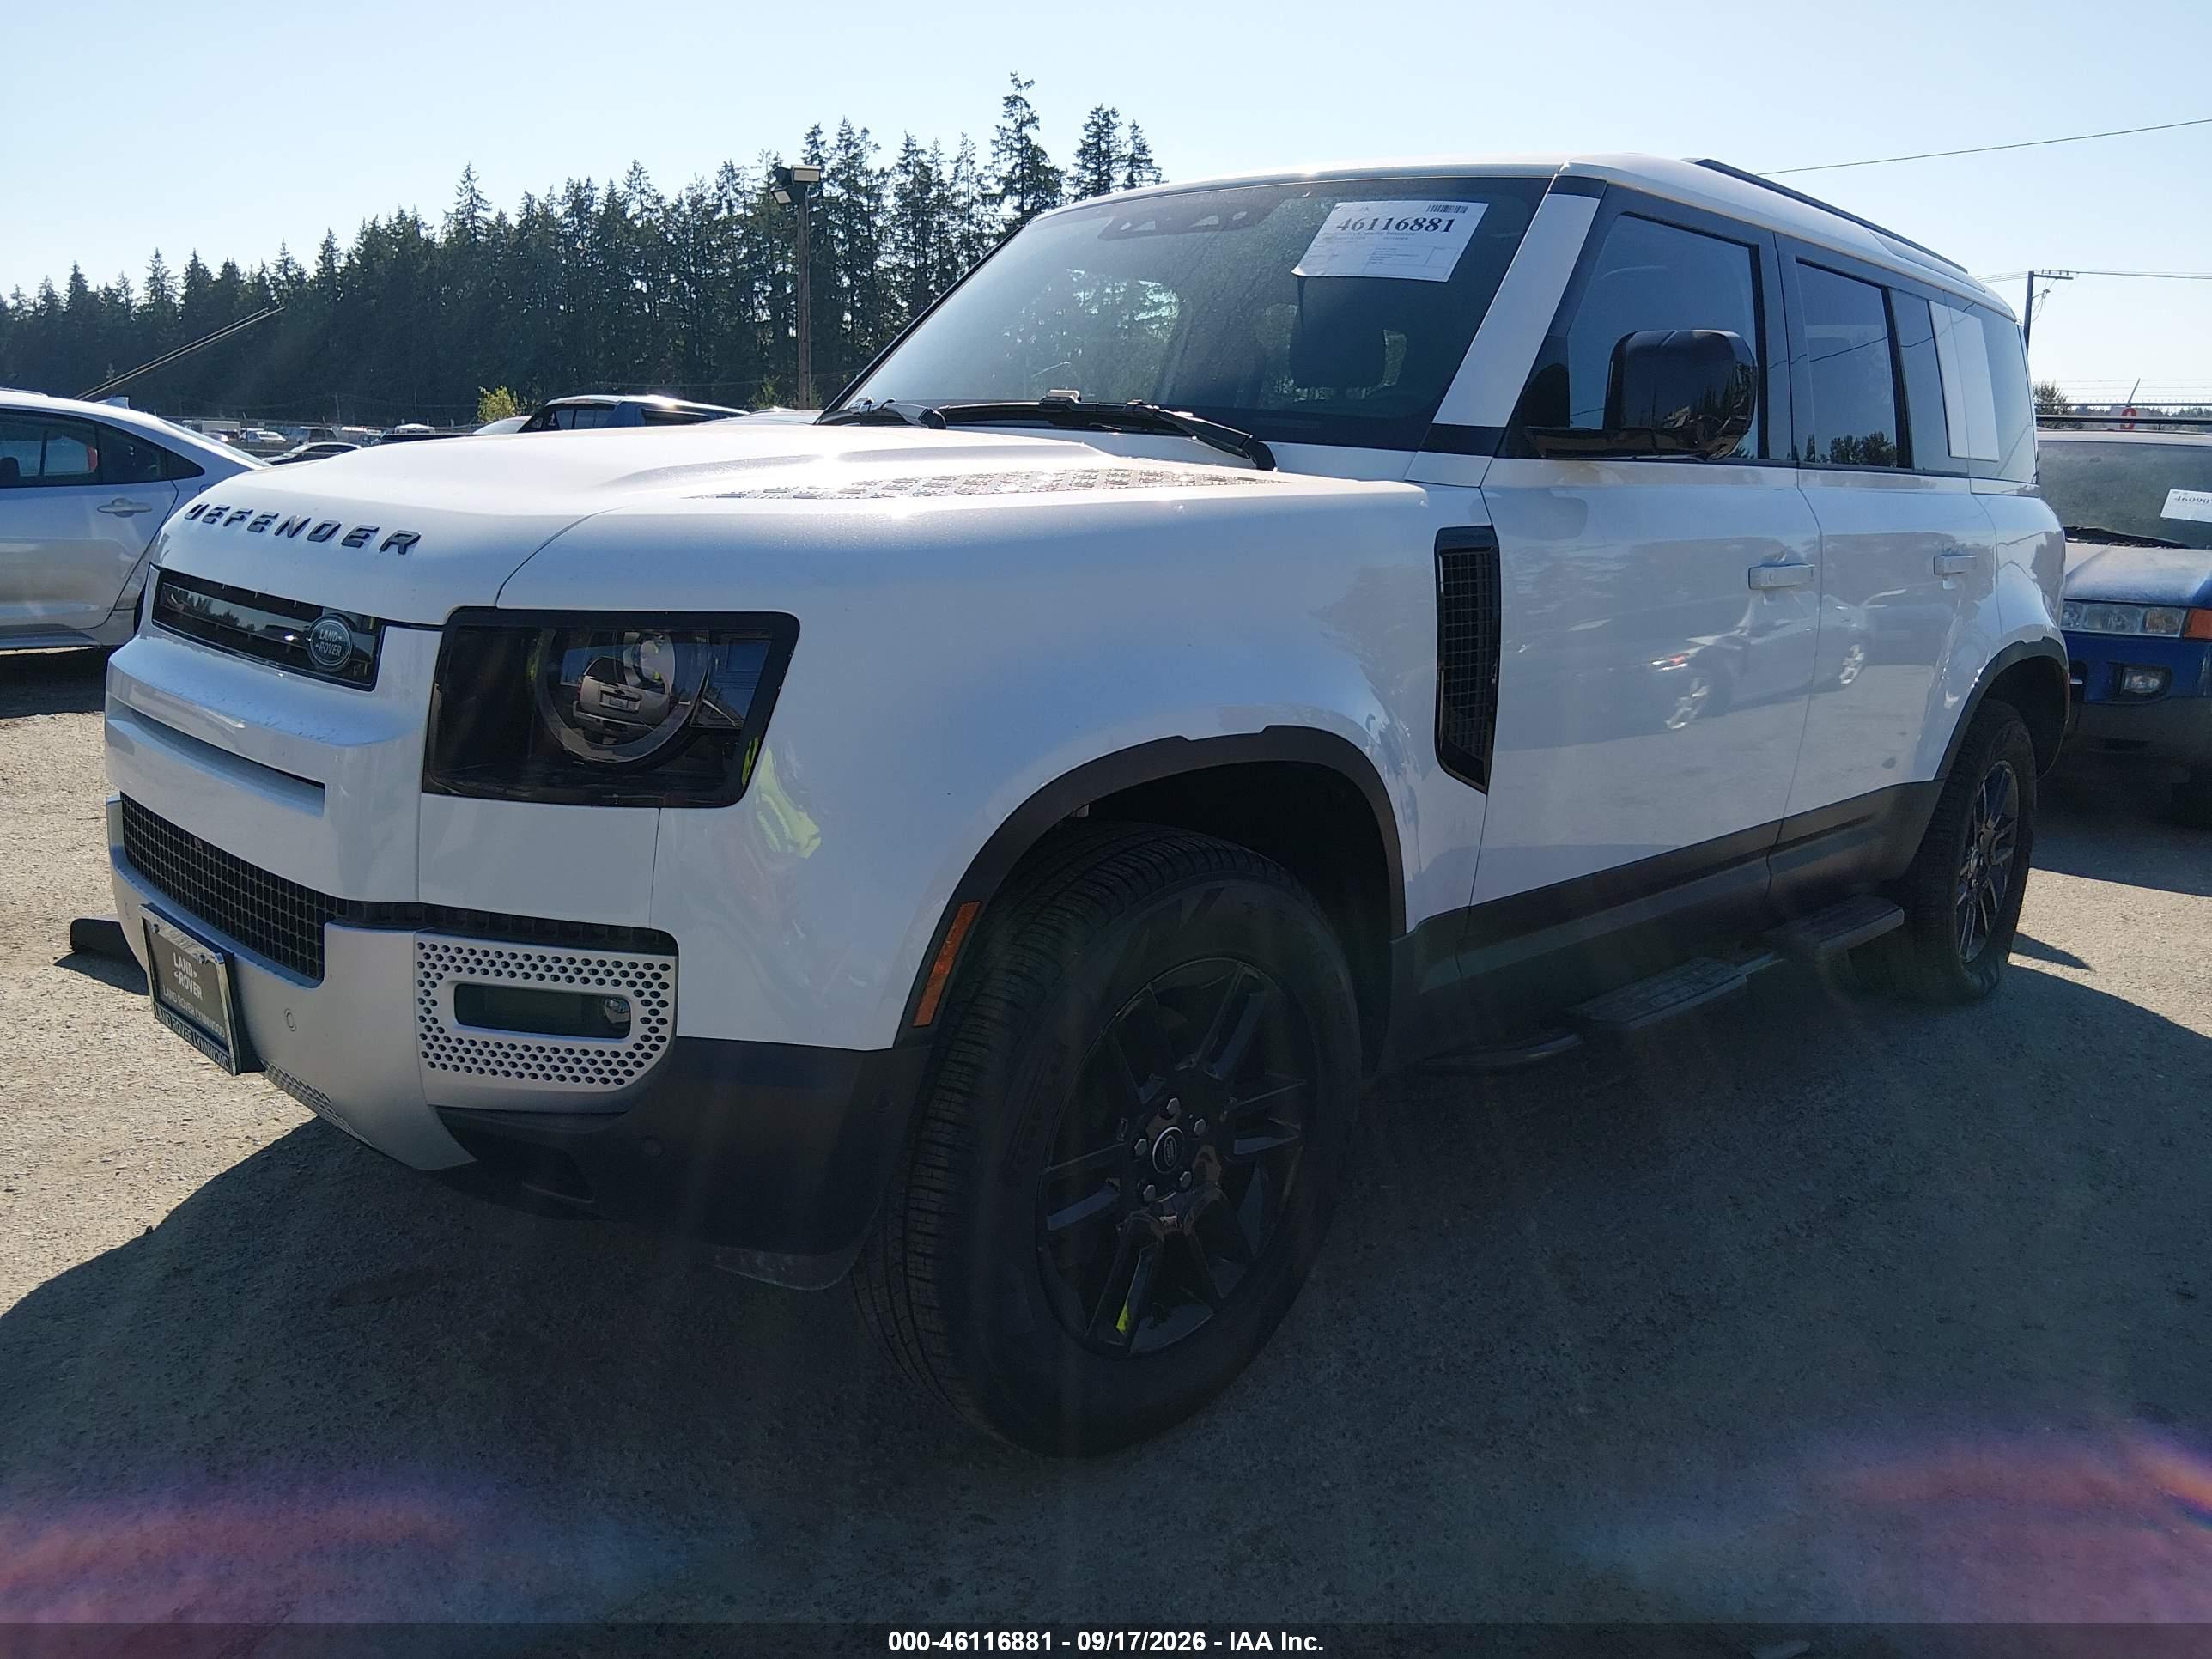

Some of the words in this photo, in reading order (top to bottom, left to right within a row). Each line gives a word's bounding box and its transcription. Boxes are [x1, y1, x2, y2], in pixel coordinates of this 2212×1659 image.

[1335, 216, 1455, 233] 46116881
[2174, 495, 2212, 504] 46090
[184, 502, 422, 556] DEFENDER
[319, 629, 338, 642] LAND
[319, 641, 343, 657] ROVER
[173, 951, 193, 976] LAND
[178, 972, 203, 1000] ROVER
